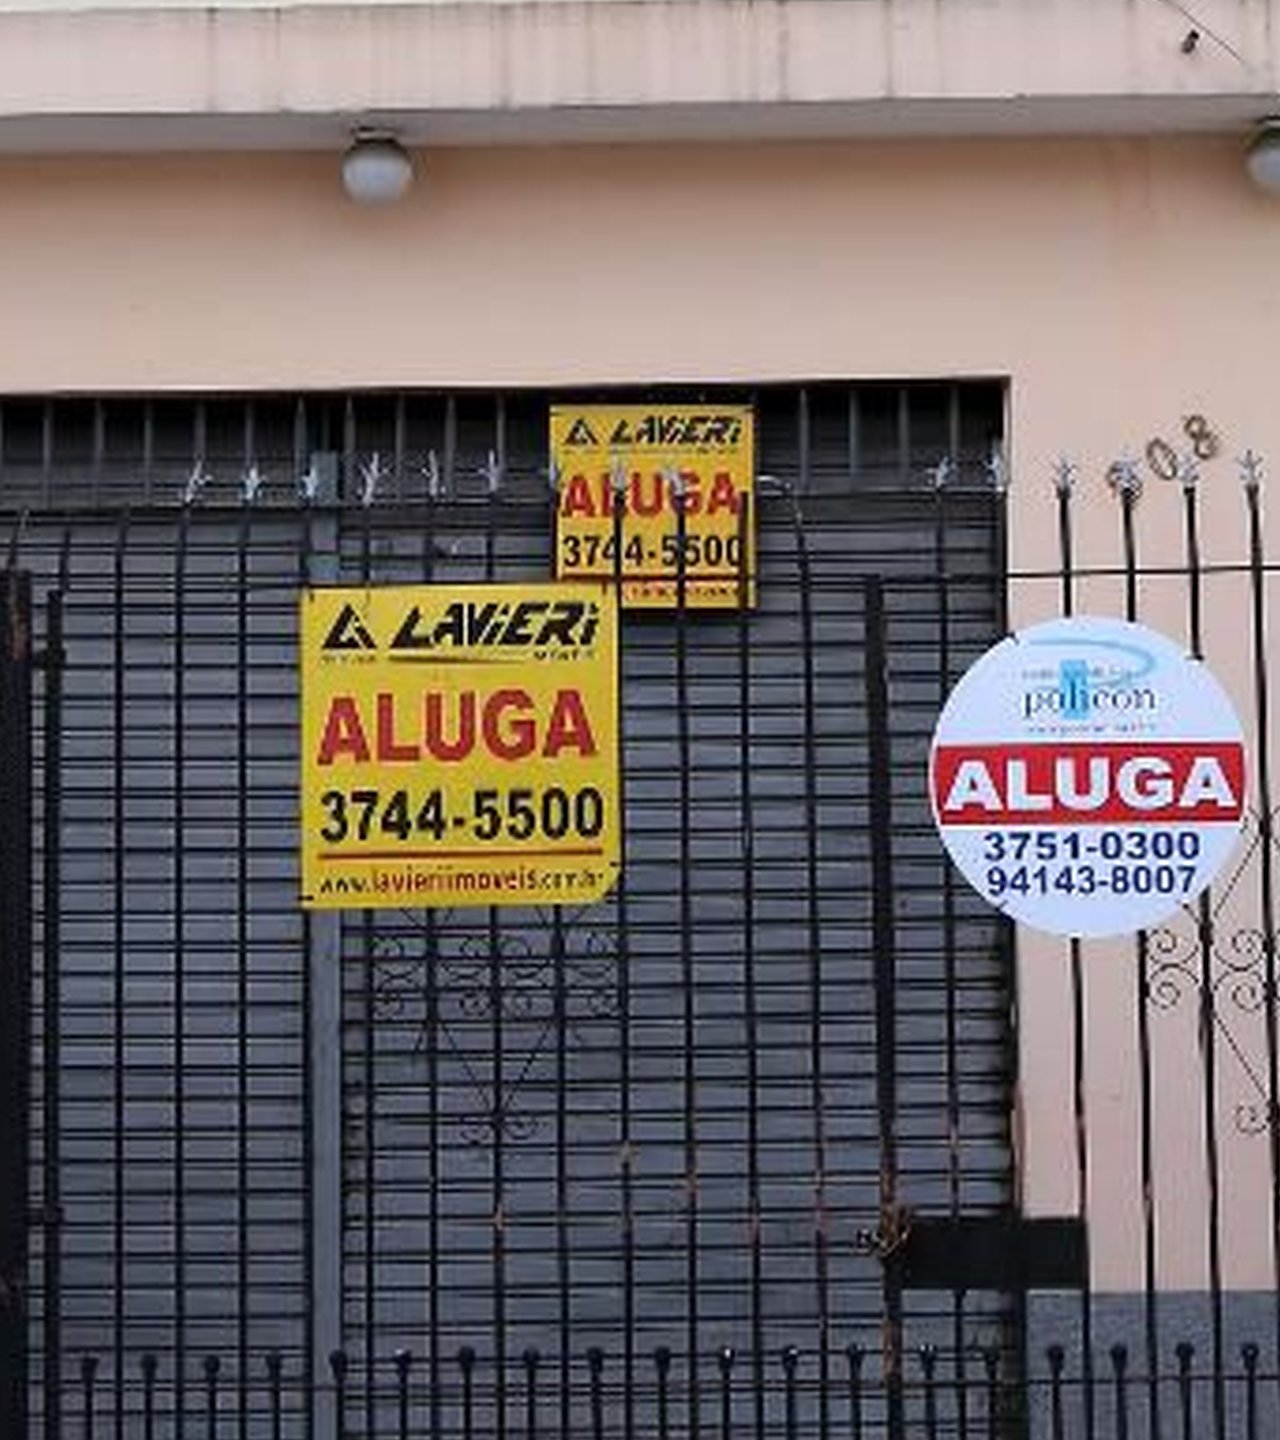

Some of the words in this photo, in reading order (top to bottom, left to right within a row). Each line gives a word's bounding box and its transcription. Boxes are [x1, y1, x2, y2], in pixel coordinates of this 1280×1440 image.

[562, 472, 742, 517] ALUGA
[563, 535, 744, 568] 3744-5500
[317, 689, 597, 765] ALUGA
[943, 757, 1238, 812] ALUGA
[320, 787, 604, 842] 3744-5500
[983, 831, 1200, 861] 3751-0300
[987, 866, 1197, 896] 94143-8007
